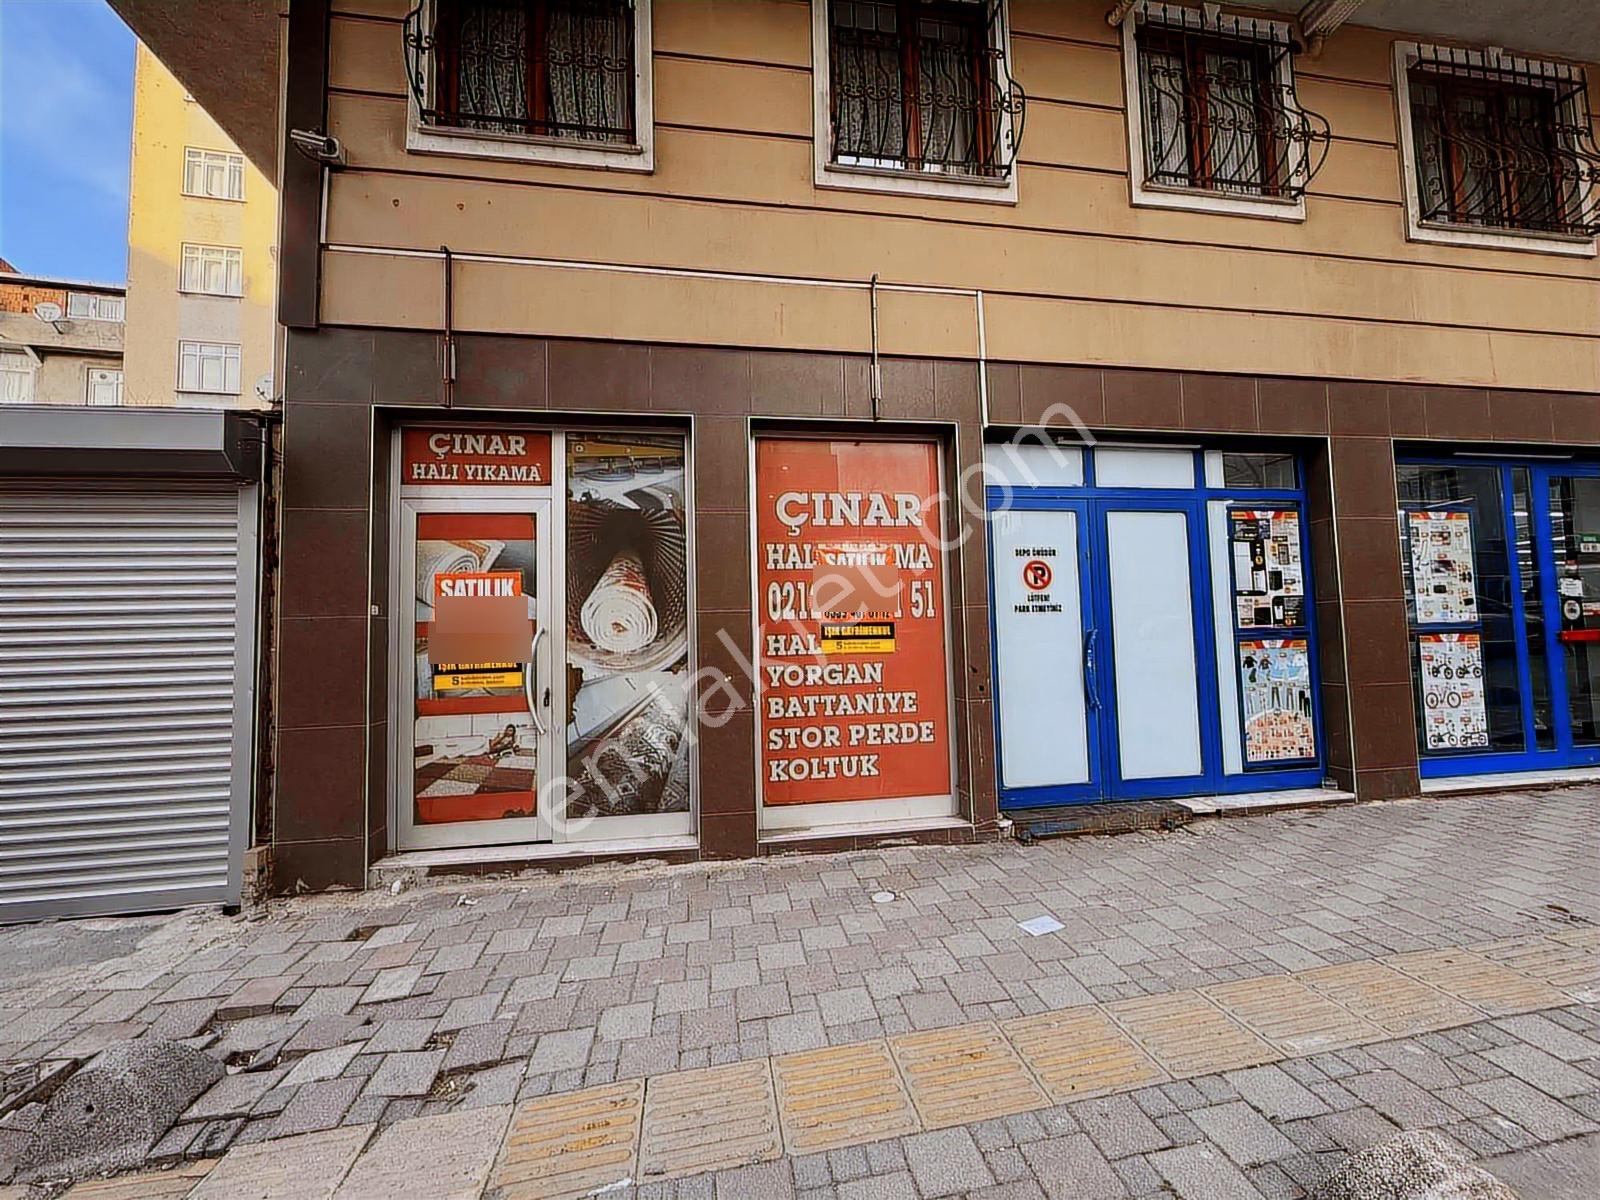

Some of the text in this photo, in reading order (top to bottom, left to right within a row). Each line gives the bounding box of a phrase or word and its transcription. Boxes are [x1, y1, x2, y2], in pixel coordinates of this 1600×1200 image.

[428, 433, 527, 460] ÇINAR
[412, 463, 542, 482] HALI YIKAMA
[775, 491, 922, 536] ÇINAR
[440, 578, 515, 597] SATILIK
[911, 581, 936, 618] 51
[766, 662, 884, 688] YORGAN
[767, 687, 918, 719] BATTANİYE
[768, 721, 936, 751] STOR PERDE
[768, 754, 880, 783] KOLTUK
